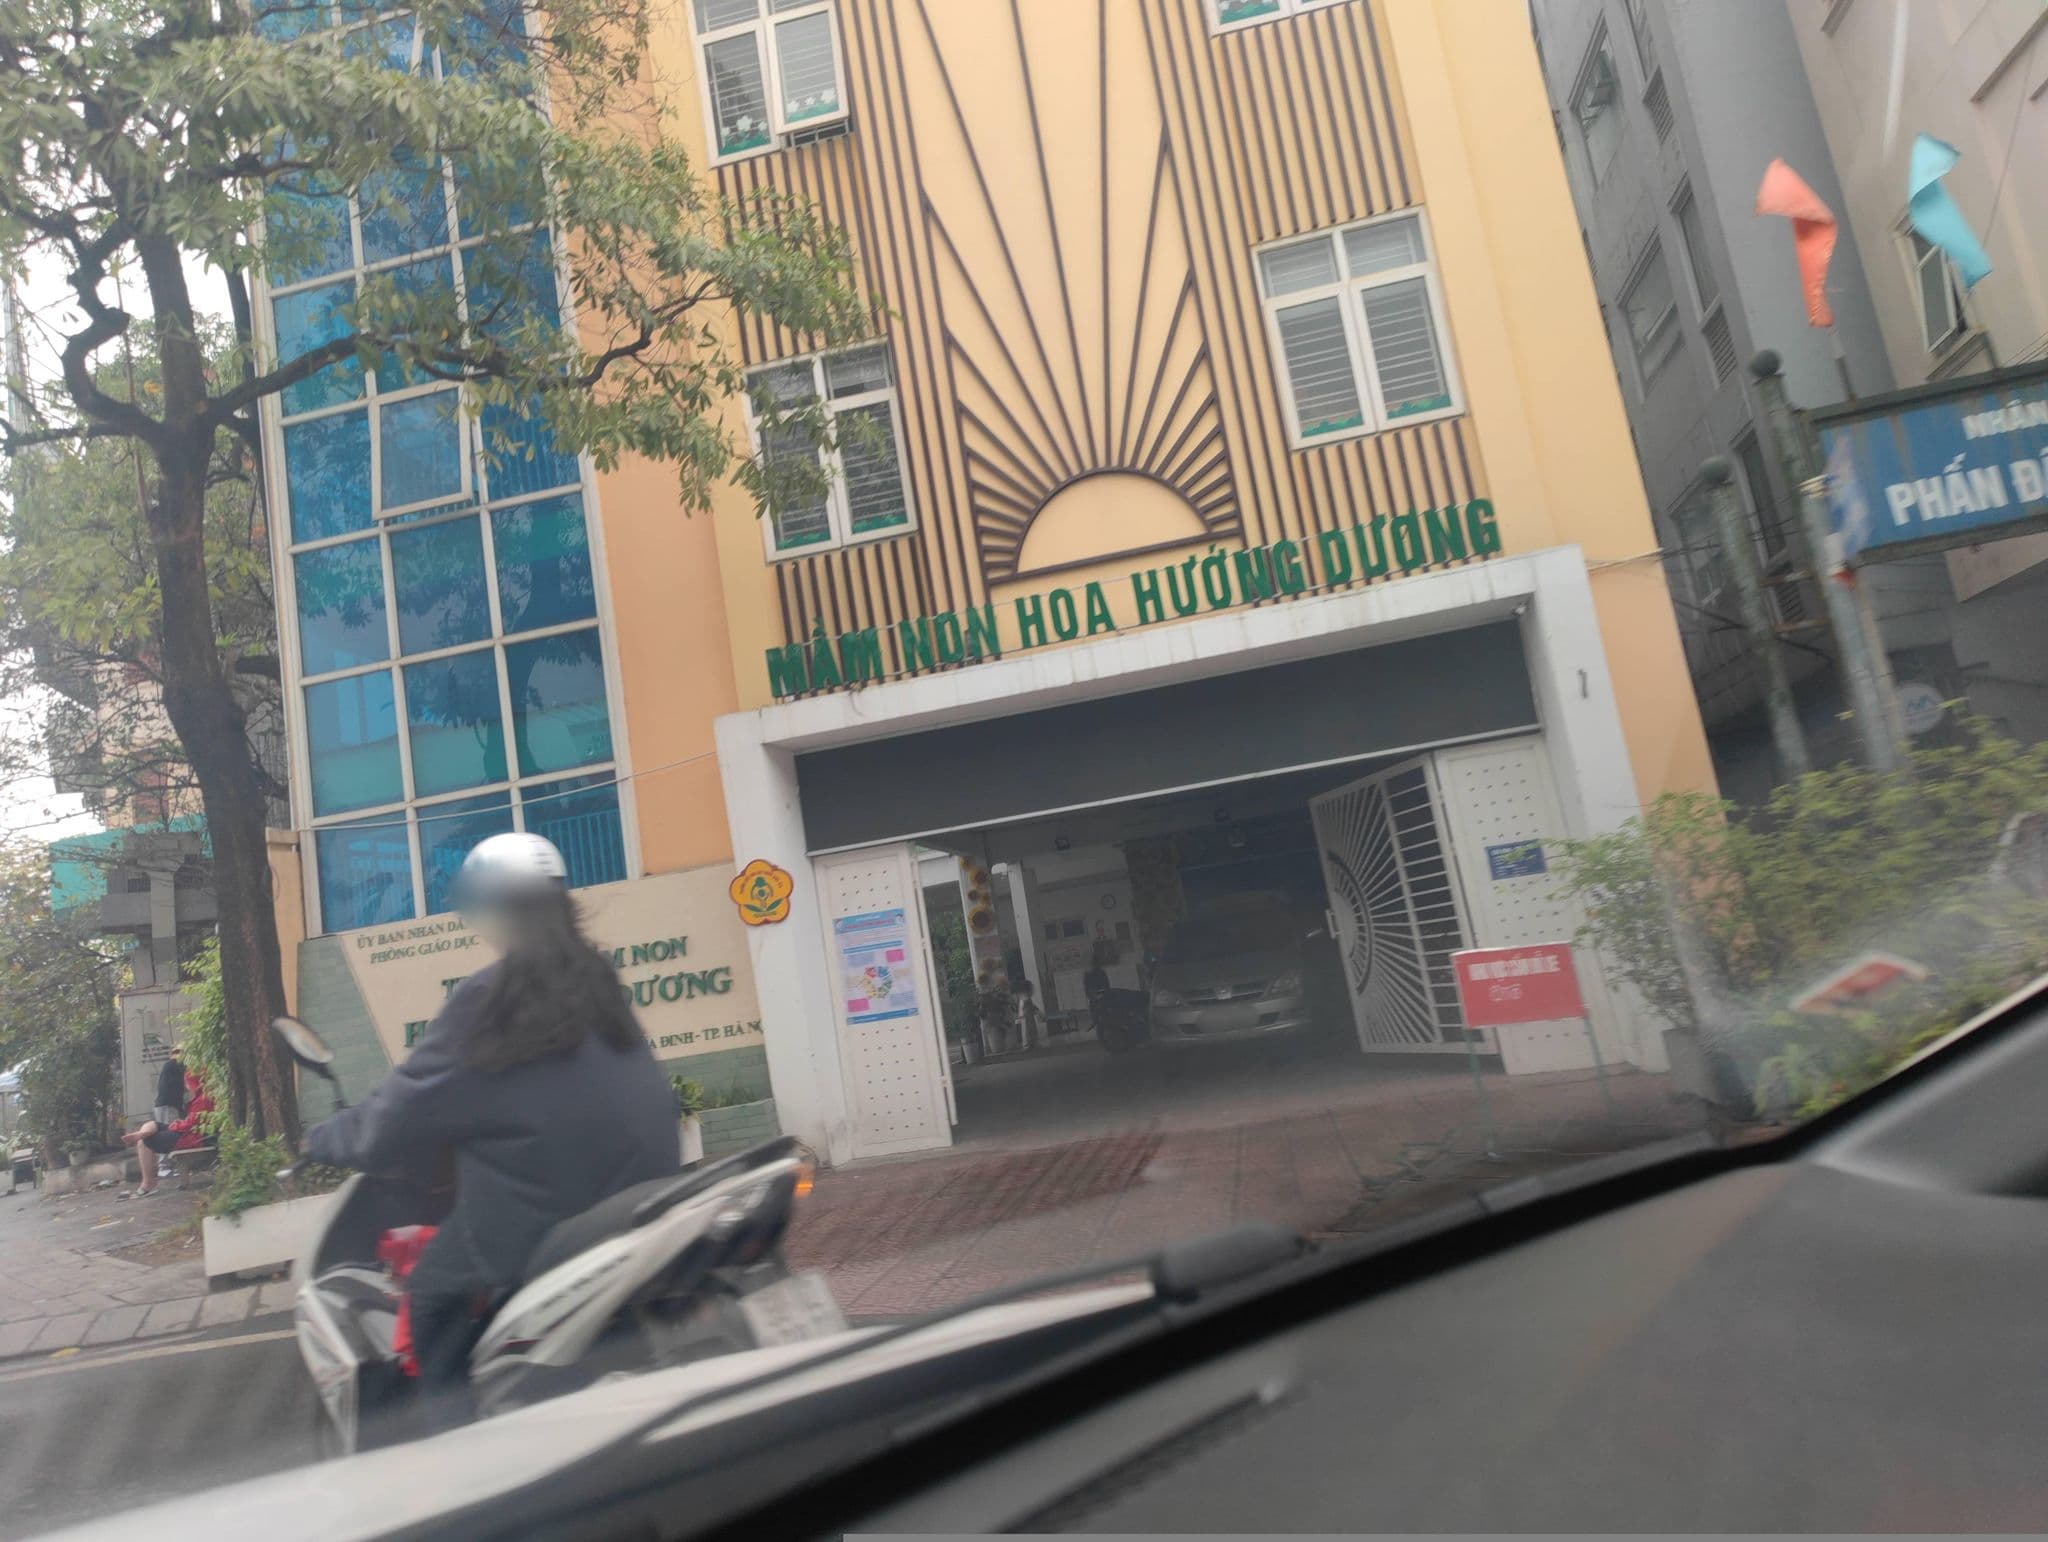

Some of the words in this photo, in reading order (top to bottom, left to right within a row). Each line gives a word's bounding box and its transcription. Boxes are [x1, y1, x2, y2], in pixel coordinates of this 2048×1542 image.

[1885, 452, 2009, 526] PHẤN
[766, 616, 884, 697] MẦM
[898, 602, 1001, 672] NON
[1017, 580, 1116, 649] HOA
[1131, 543, 1305, 624] HƯỚNG
[1317, 497, 1503, 586] DƯƠNG
[370, 946, 416, 964] PHÒNG
[418, 938, 451, 955] GIÁO
[454, 935, 480, 950] DỤC
[378, 930, 405, 945] BAN
[631, 936, 688, 964] NON
[723, 1021, 744, 1037] HÀ
